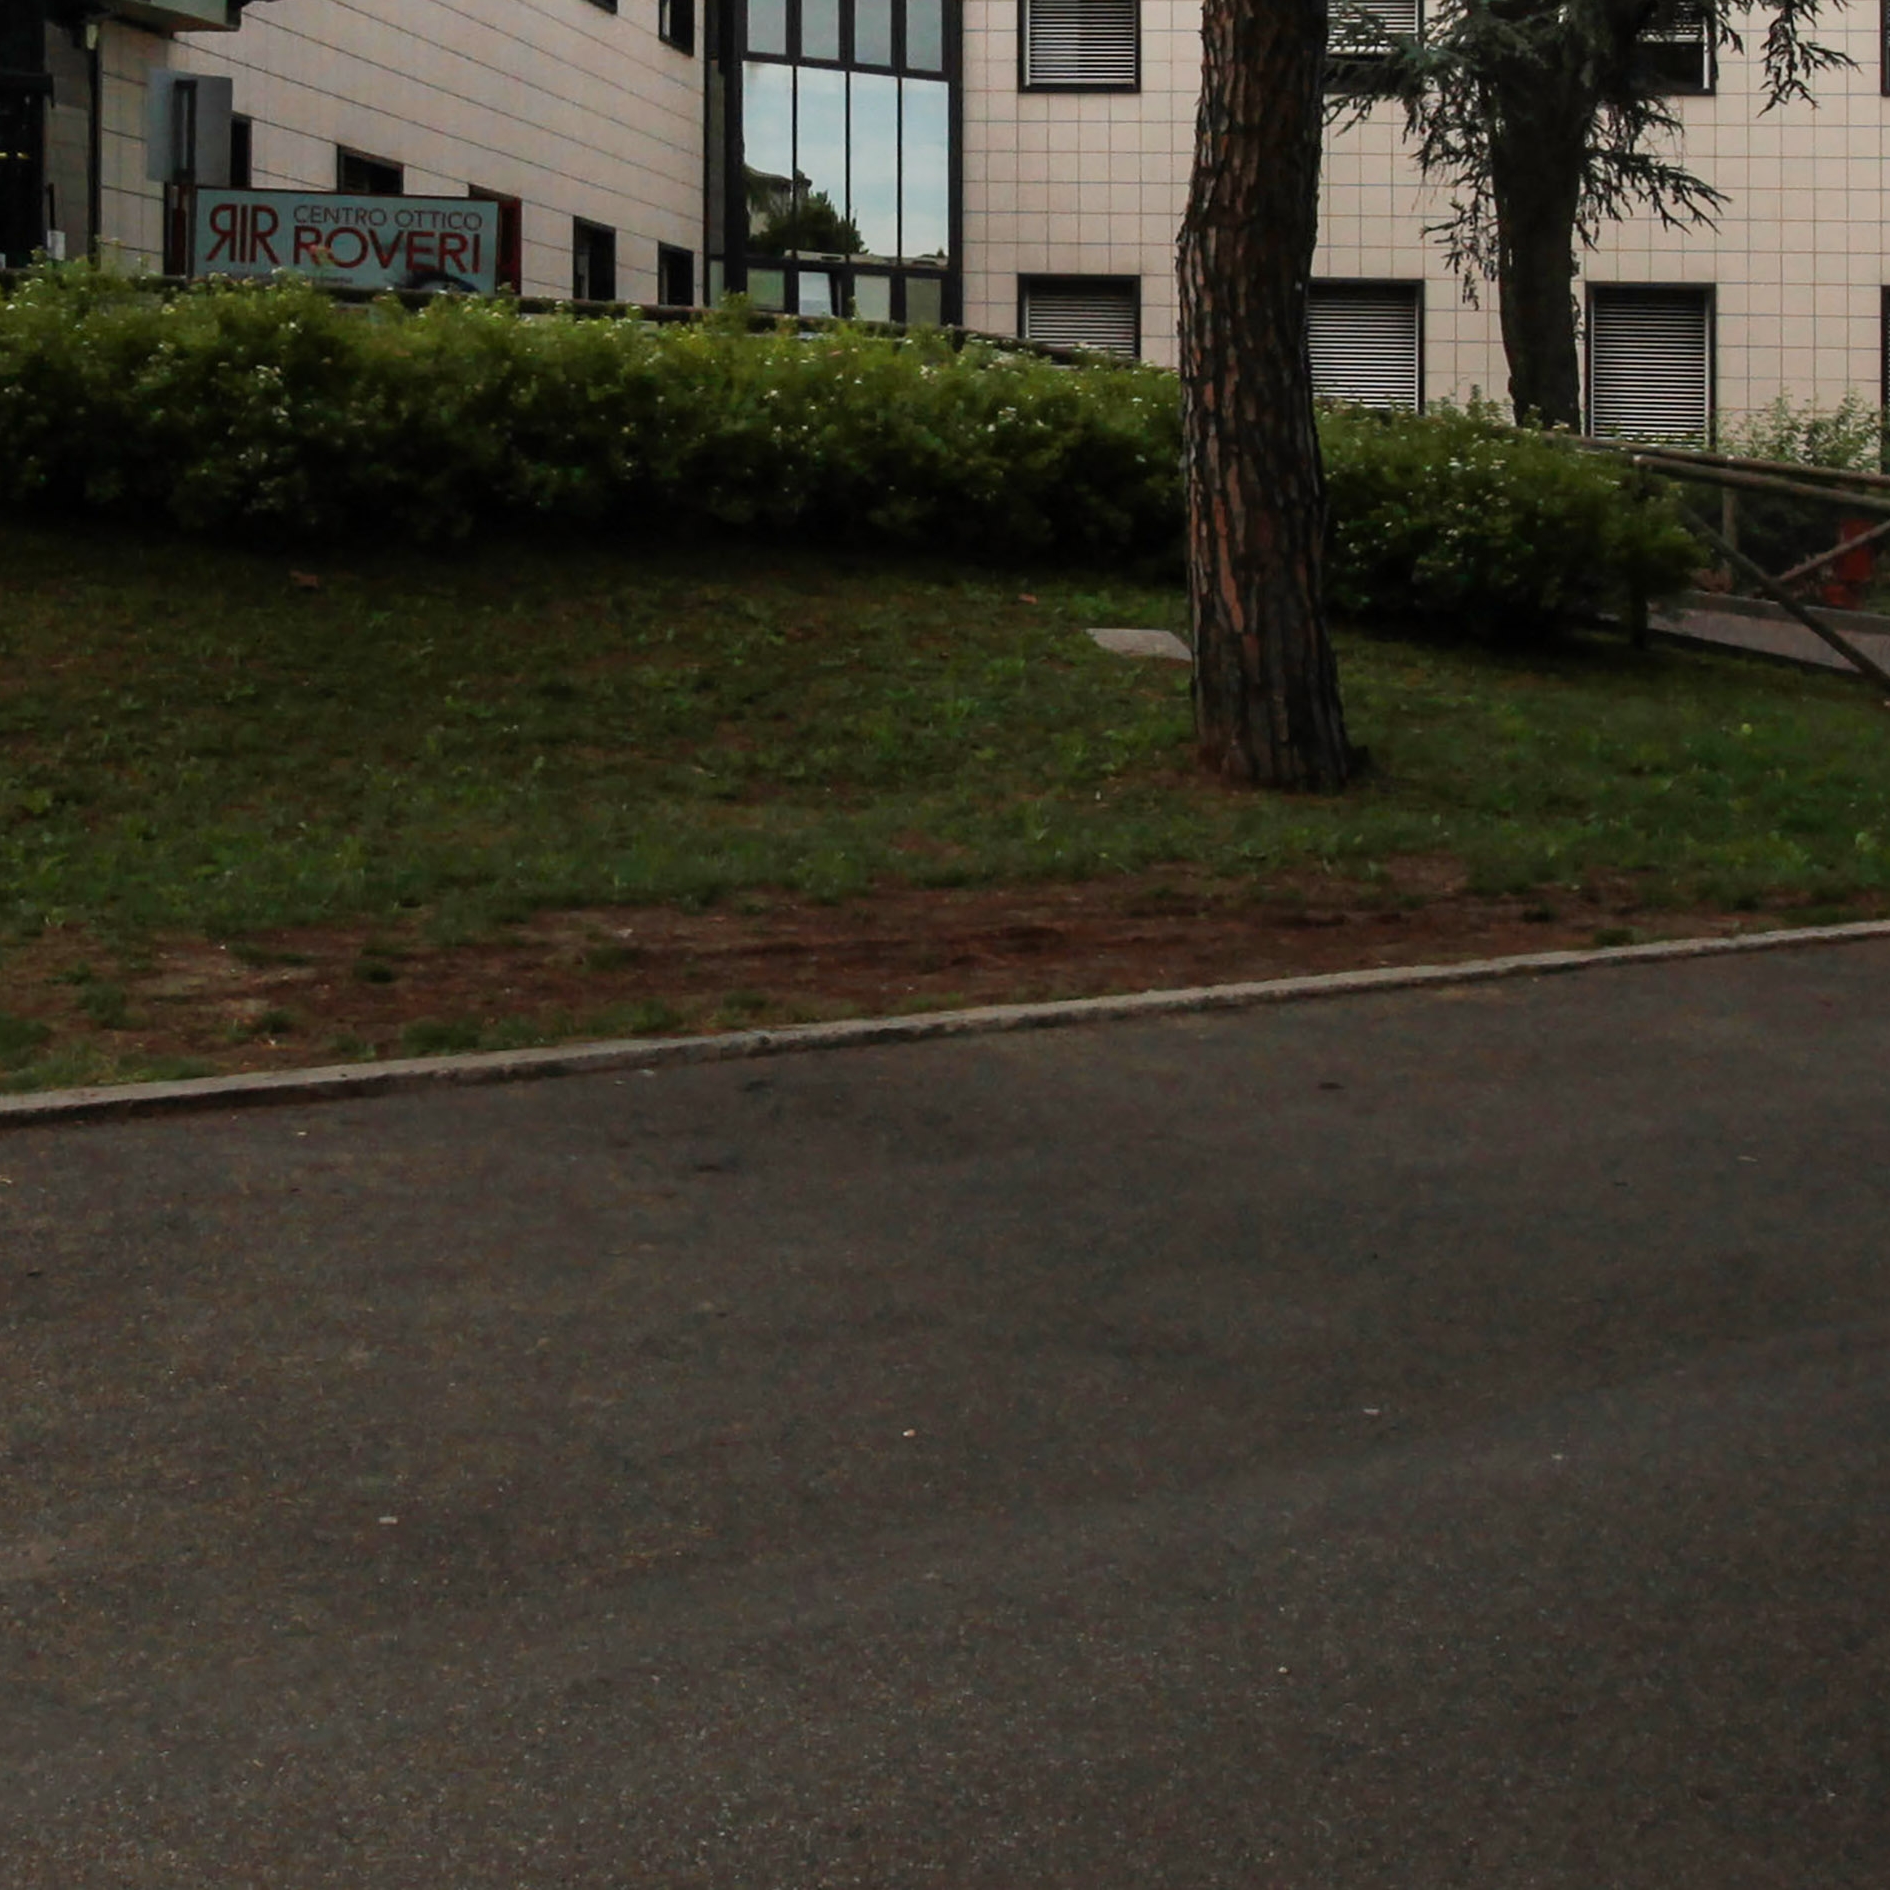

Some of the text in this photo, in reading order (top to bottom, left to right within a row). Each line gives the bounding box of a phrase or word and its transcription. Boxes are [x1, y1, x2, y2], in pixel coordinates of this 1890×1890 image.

[292, 204, 483, 232] CENTRO OTTICO
[292, 225, 482, 274] ROVERI
